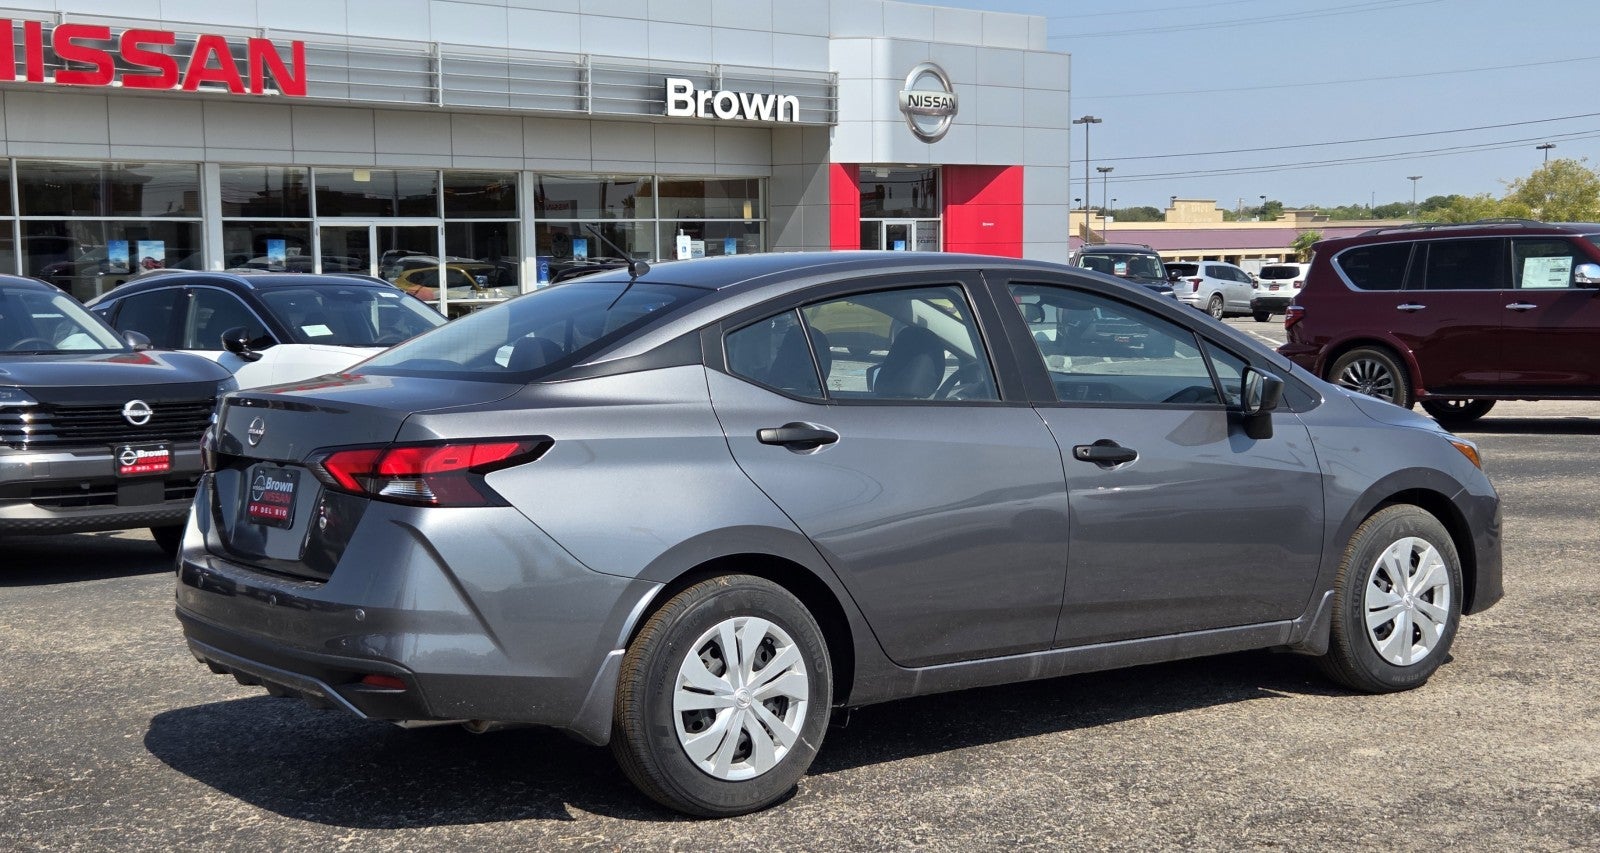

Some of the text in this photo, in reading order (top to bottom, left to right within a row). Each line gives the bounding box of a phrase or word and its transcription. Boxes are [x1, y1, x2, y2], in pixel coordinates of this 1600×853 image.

[0, 18, 307, 97] ISSAN
[665, 77, 800, 122] Brown
[908, 94, 956, 109] NISSAN
[136, 450, 169, 458] Brown
[265, 477, 293, 493] Brown
[260, 506, 272, 515] DEL
